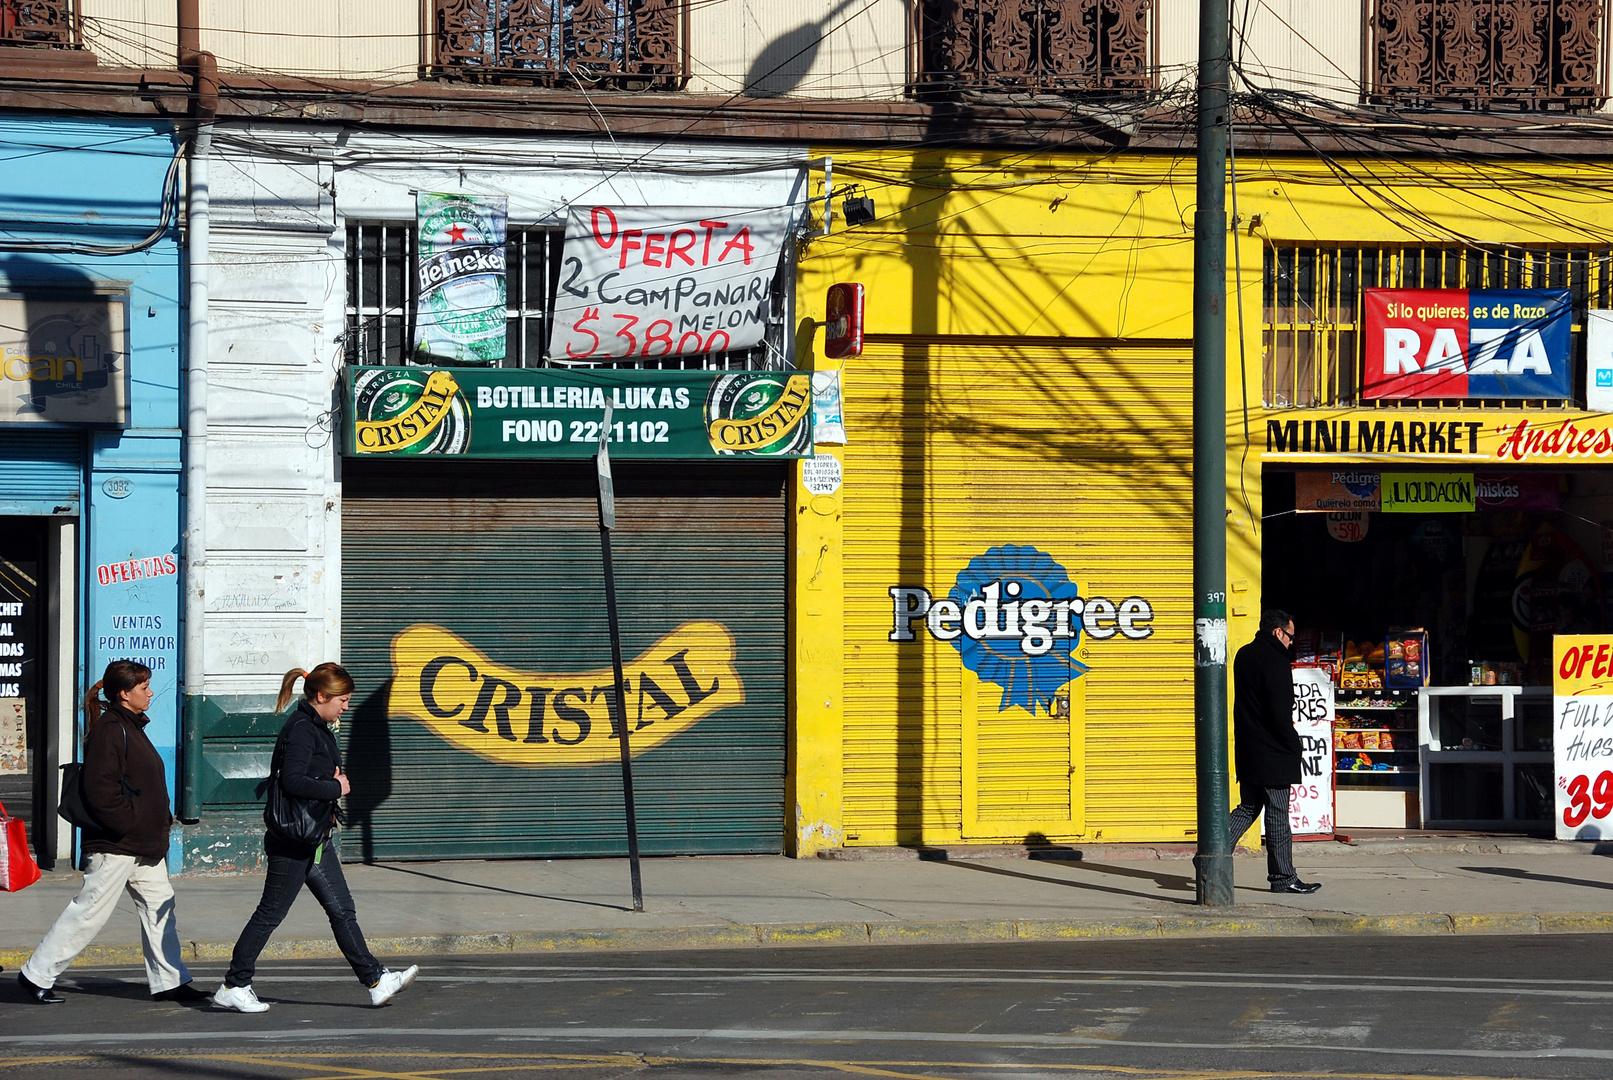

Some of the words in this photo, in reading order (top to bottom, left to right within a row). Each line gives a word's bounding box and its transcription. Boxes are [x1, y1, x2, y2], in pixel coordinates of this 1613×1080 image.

[449, 209, 478, 223] LAGER
[591, 206, 755, 269] OFERTA
[562, 256, 589, 298] 2
[679, 309, 761, 333] MELON
[1387, 303, 1398, 319] Si
[1401, 303, 1413, 319] lo
[1417, 303, 1470, 321] quieres,
[1473, 307, 1489, 319] es
[1491, 303, 1510, 319] de
[1513, 303, 1549, 319] Raza.
[1383, 328, 1553, 375] RAZA
[361, 371, 411, 404] CERVEZA
[477, 386, 606, 409] BOTILLERIA
[612, 387, 690, 409] LUKAS
[357, 386, 450, 447] CRISTAL
[502, 420, 563, 442] FONO
[719, 387, 809, 446] CRISTAL
[1266, 419, 1350, 453] MINI
[1357, 420, 1484, 454] MARKET
[1353, 499, 1376, 507] como
[96, 553, 177, 587] OFERTAS
[1206, 591, 1226, 604] 397
[112, 615, 163, 630] VENTAS
[887, 578, 1155, 656] Pedigree
[99, 636, 125, 650] POR
[129, 636, 175, 650] MAYOR
[419, 649, 720, 746] CRISTAL
[1560, 701, 1600, 730] FULL
